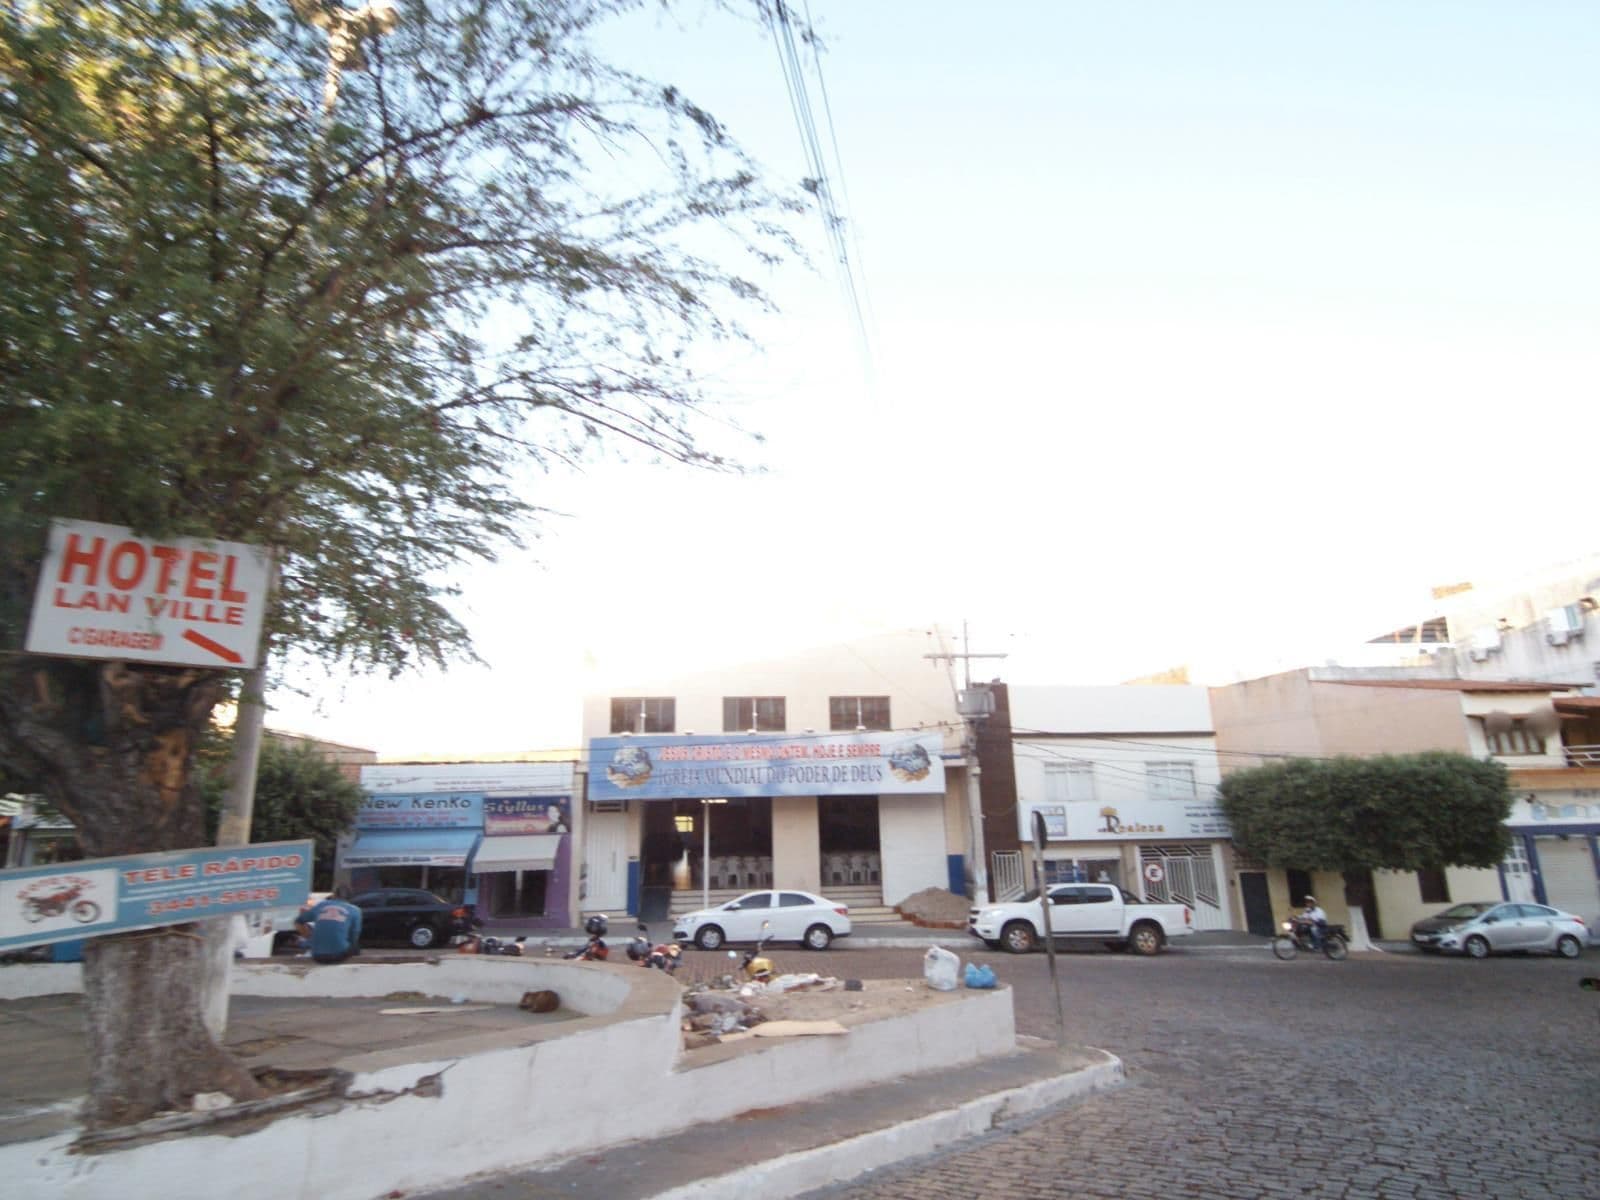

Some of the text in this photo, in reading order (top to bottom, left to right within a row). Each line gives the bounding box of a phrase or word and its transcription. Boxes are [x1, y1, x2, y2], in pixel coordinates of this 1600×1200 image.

[58, 534, 247, 603] HOTEL
[53, 588, 245, 625] LAN VILLE
[703, 766, 767, 785] MUNDIAL
[787, 766, 829, 784] PODER
[832, 765, 849, 783] DE
[850, 764, 882, 783] DEUS
[124, 864, 196, 885] TELE
